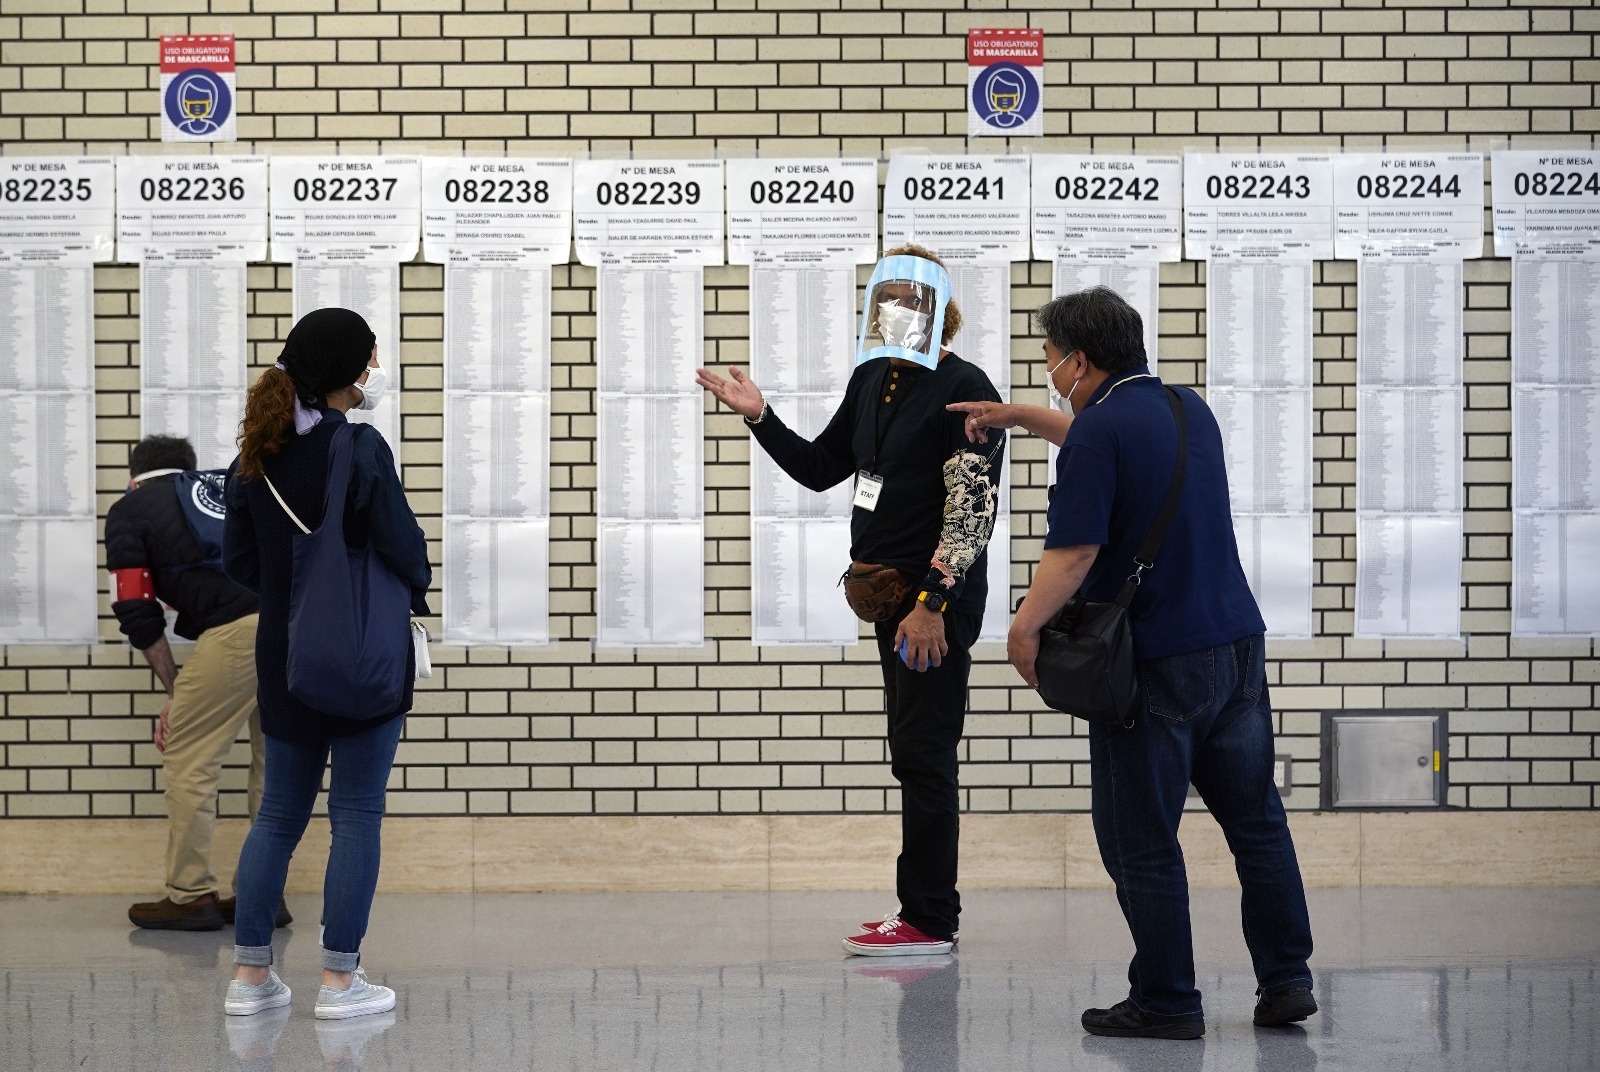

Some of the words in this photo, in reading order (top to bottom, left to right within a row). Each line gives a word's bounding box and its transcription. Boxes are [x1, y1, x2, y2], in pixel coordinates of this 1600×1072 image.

[177, 162, 190, 171] DE
[192, 162, 219, 171] MESA
[940, 162, 953, 170] DE
[955, 162, 982, 170] MESA
[1093, 161, 1105, 171] DE
[1108, 161, 1135, 171] MESA
[1244, 160, 1257, 169] DE
[1259, 160, 1286, 169] MESA
[1394, 160, 1407, 168] DE
[1409, 160, 1436, 168] MESA
[1551, 157, 1564, 166] DE
[1566, 157, 1593, 166] MESA
[24, 163, 37, 172] DE
[39, 163, 66, 172] MESA
[331, 163, 344, 172] DE
[346, 163, 373, 172] MESA
[483, 164, 496, 173] DE
[498, 164, 525, 173] MESA
[634, 166, 647, 175] DE
[649, 166, 676, 175] MESA
[788, 165, 800, 174] DE
[803, 165, 829, 174] MESA
[0, 178, 92, 202] 82235
[140, 177, 245, 201] 082236
[294, 178, 398, 201] 082237
[445, 179, 550, 203] 082238
[904, 177, 1004, 200] 082241
[1055, 177, 1159, 201] 082242
[1206, 175, 1311, 198] 082243
[1357, 175, 1461, 198] 082244
[597, 181, 701, 205] 082239
[751, 180, 854, 204] 082240
[860, 490, 875, 500] STAFF
